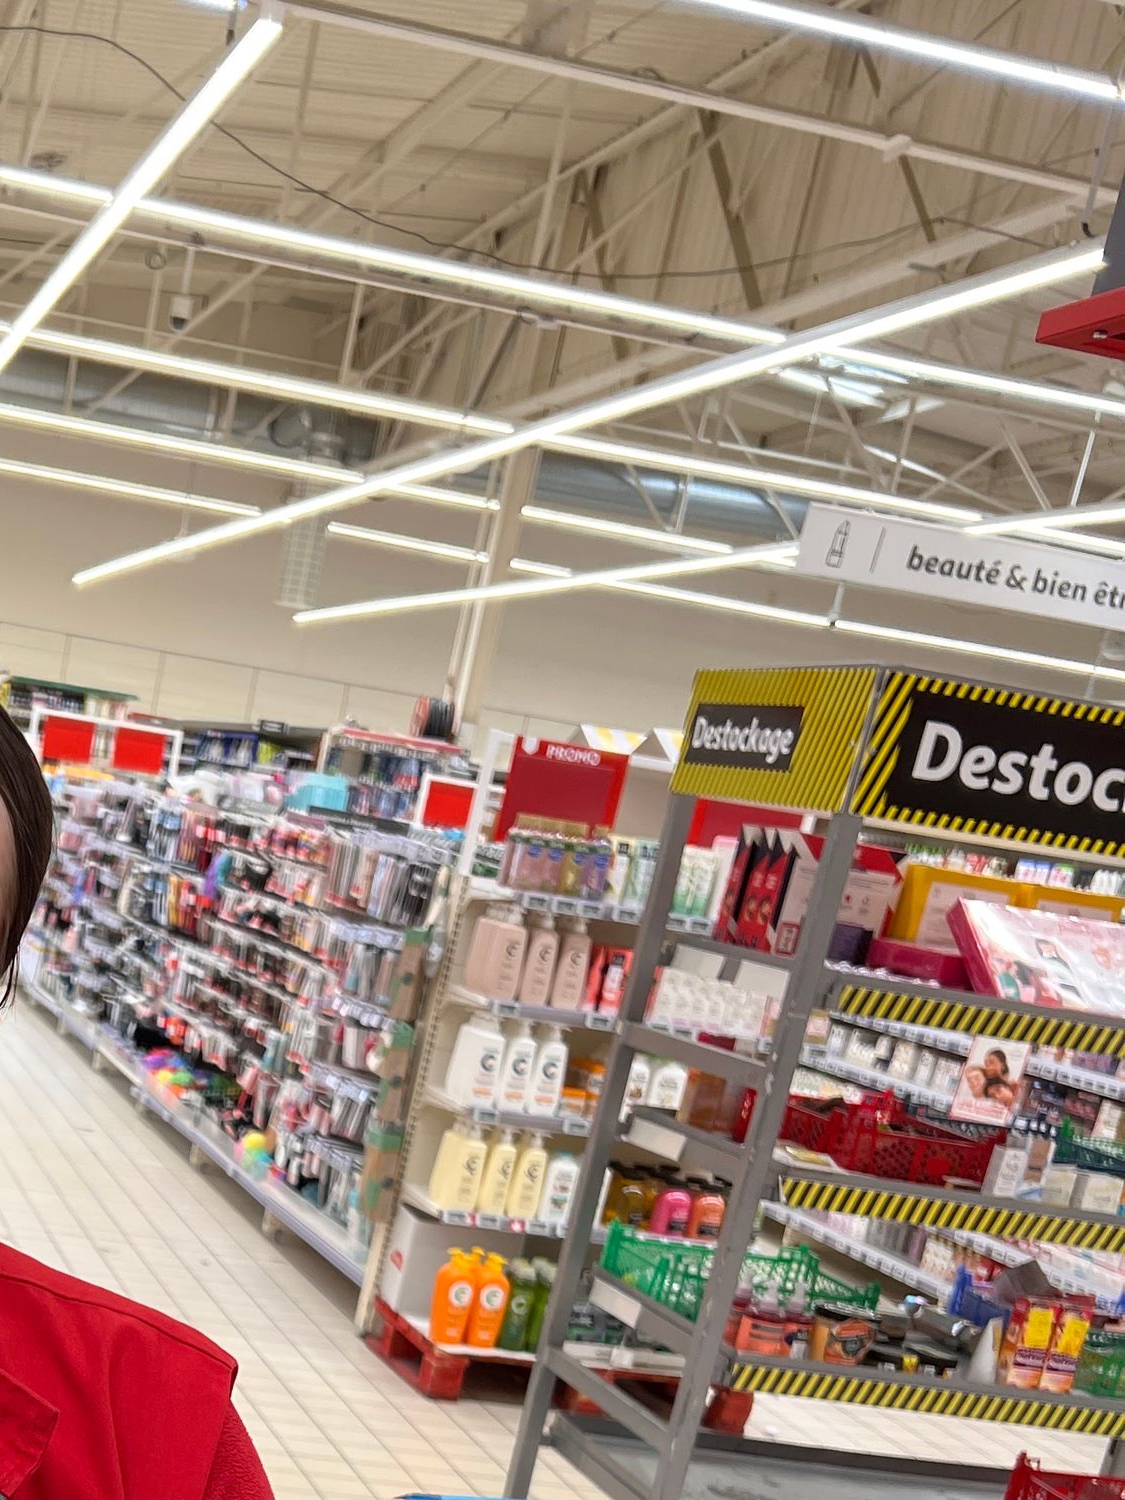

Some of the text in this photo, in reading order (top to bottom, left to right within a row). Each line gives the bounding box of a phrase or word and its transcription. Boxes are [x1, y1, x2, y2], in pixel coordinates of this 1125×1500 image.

[906, 545, 1002, 585] beauté
[1005, 565, 1026, 591] &
[1032, 569, 1087, 602] bien
[546, 744, 601, 766] PROMO
[691, 716, 795, 763] Destockage
[911, 720, 1125, 813] Destoc
